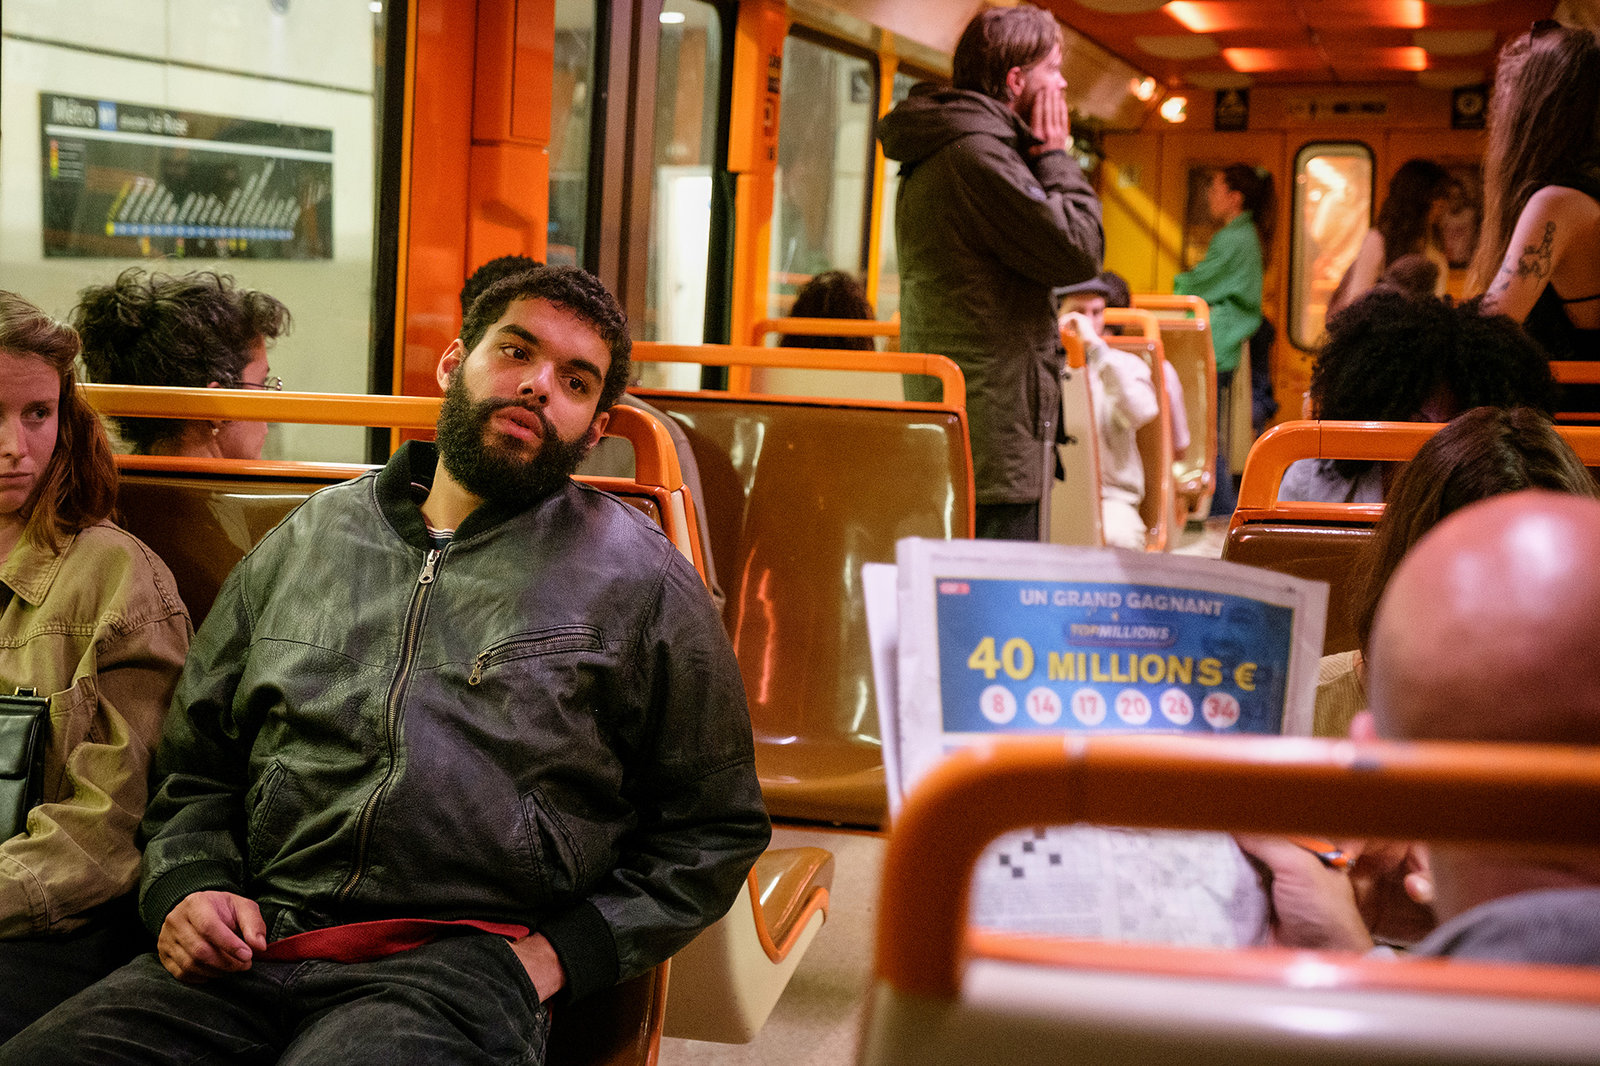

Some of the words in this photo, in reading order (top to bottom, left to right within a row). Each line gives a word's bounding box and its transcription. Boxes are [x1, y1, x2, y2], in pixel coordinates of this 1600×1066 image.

[1020, 589, 1048, 606] UN
[1053, 590, 1122, 608] GRAND
[1126, 593, 1224, 616] GAGNANT
[967, 636, 1035, 680] 40
[1048, 652, 1223, 686] MILLIONS
[1234, 662, 1258, 691] €
[992, 693, 1006, 714] 8
[1032, 695, 1055, 715] 14
[1078, 695, 1098, 715] 17
[1121, 697, 1146, 716] 20
[1166, 696, 1189, 716] 26
[1207, 697, 1235, 719] 34
